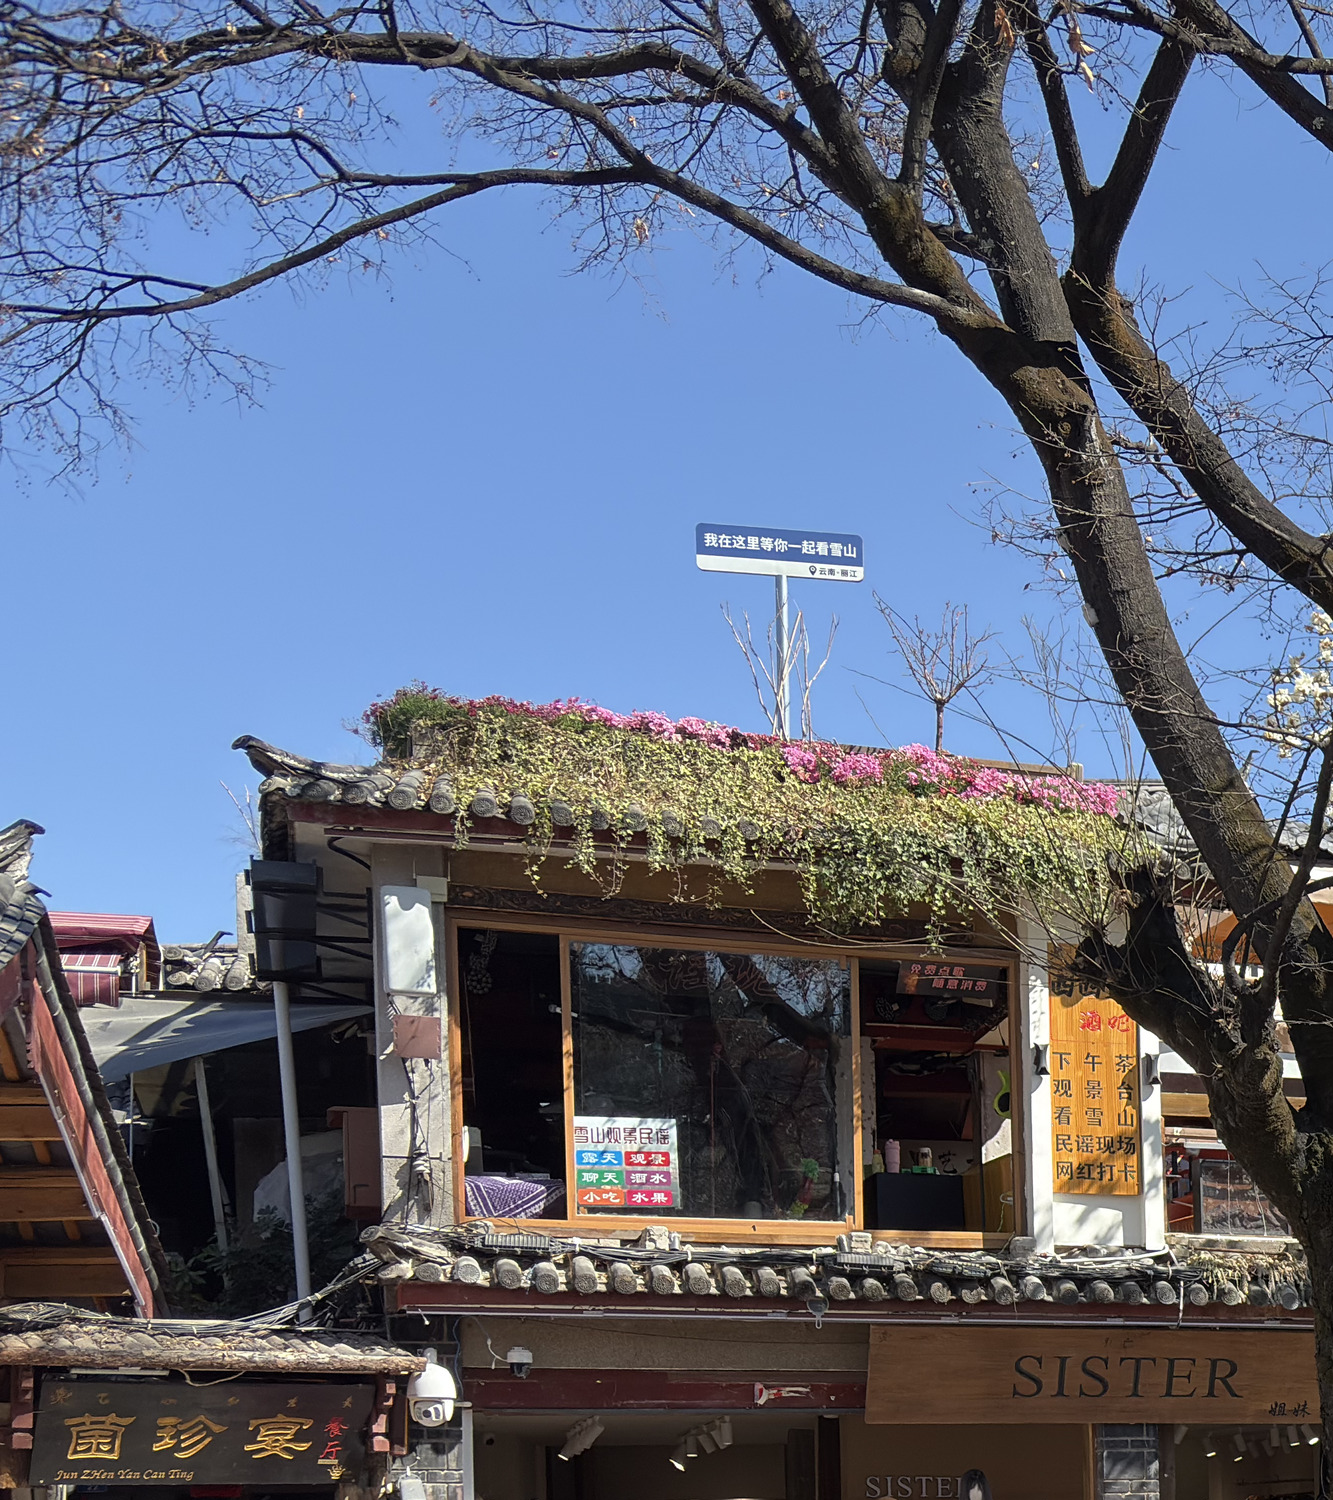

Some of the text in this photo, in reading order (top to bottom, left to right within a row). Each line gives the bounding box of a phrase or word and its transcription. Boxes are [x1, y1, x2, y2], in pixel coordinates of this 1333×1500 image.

[703, 532, 857, 558] 我在这里等你一起看雪山
[1079, 1010, 1131, 1033] 酒吧
[1052, 1051, 1137, 1074] 下午茶
[1053, 1079, 1135, 1102] 观景台
[1053, 1106, 1135, 1128] 看雪山
[574, 1126, 670, 1145] 雪山观景民谣
[1055, 1134, 1136, 1155] 民谣现场
[581, 1152, 619, 1164] 露天
[629, 1153, 666, 1165] 观景
[581, 1172, 620, 1184] 聊天
[1056, 1161, 1137, 1182] 网红打卡
[583, 1191, 621, 1203] 小吃
[631, 1192, 669, 1204] 水果
[1012, 1355, 1244, 1398] SISTER
[1268, 1400, 1311, 1418] 姐妹
[64, 1412, 313, 1460] 菌珍宴
[54, 1470, 78, 1481] Jun
[117, 1470, 141, 1480] Yan
[143, 1470, 165, 1480] Can
[168, 1470, 194, 1481] Ting
[866, 1476, 961, 1498] SISTE
